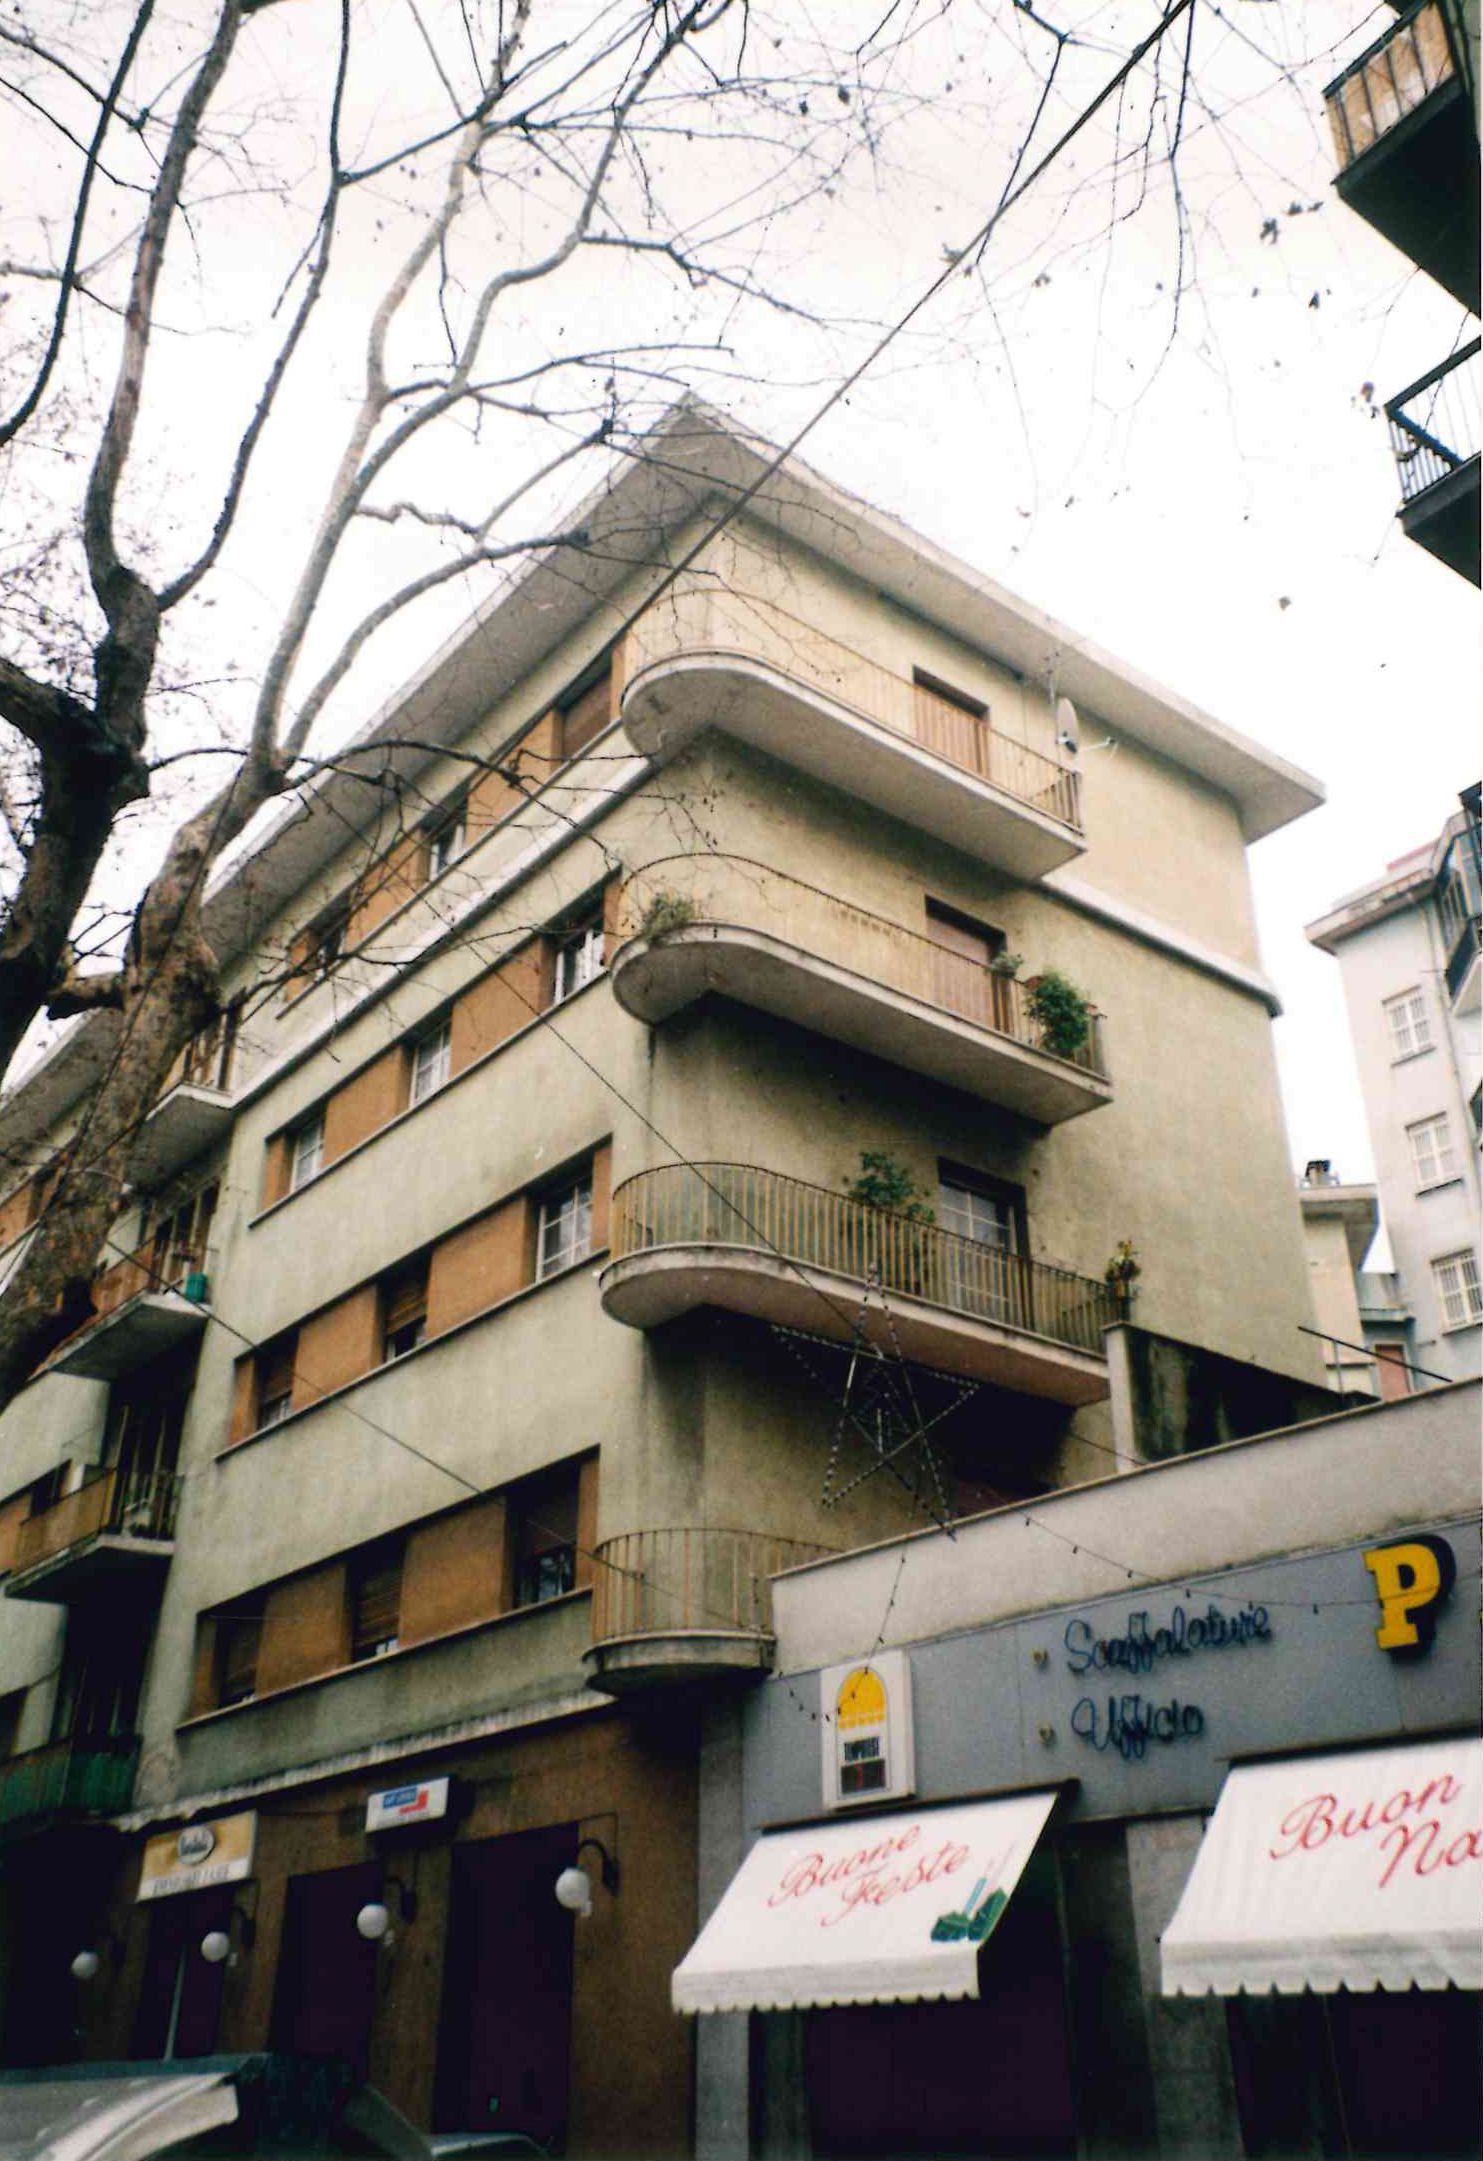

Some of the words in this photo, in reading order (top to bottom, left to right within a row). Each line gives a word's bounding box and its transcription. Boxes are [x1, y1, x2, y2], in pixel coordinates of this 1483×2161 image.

[1065, 1605, 1273, 1674] Scaffalature
[1362, 1540, 1450, 1655] P
[1270, 1774, 1462, 1860] Buon
[767, 1824, 920, 1908] Buone
